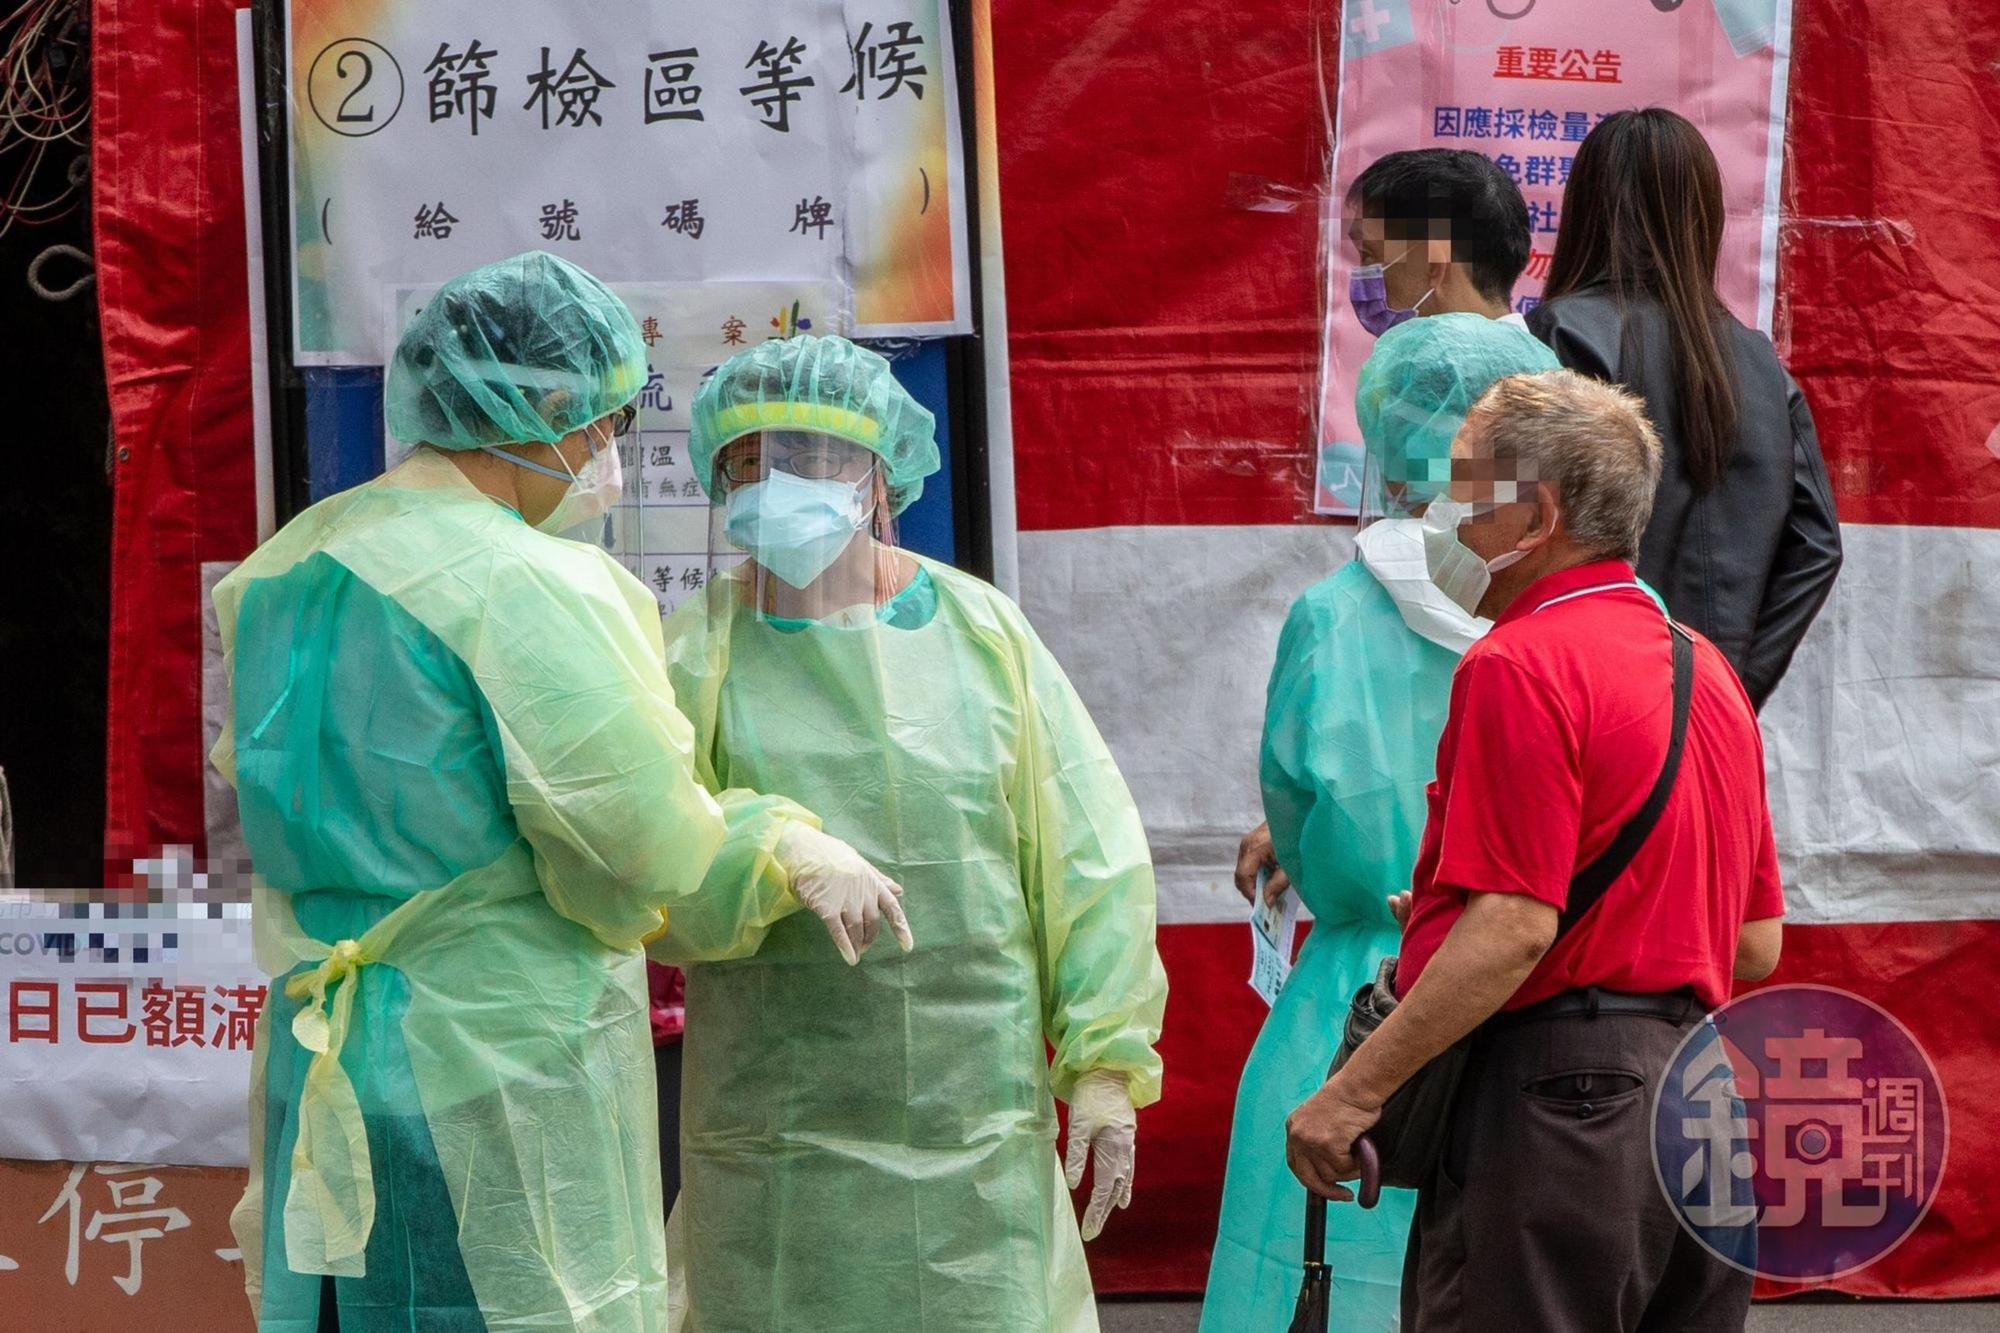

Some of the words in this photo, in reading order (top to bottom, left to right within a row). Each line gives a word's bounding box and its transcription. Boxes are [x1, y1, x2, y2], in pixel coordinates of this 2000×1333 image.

[1493, 46, 1622, 83] 重要公告
[1434, 106, 1614, 142] 因應採檢量
[1484, 153, 1575, 186] 免群
[642, 315, 748, 347] 專案
[9, 980, 268, 1051] 日已額滿
